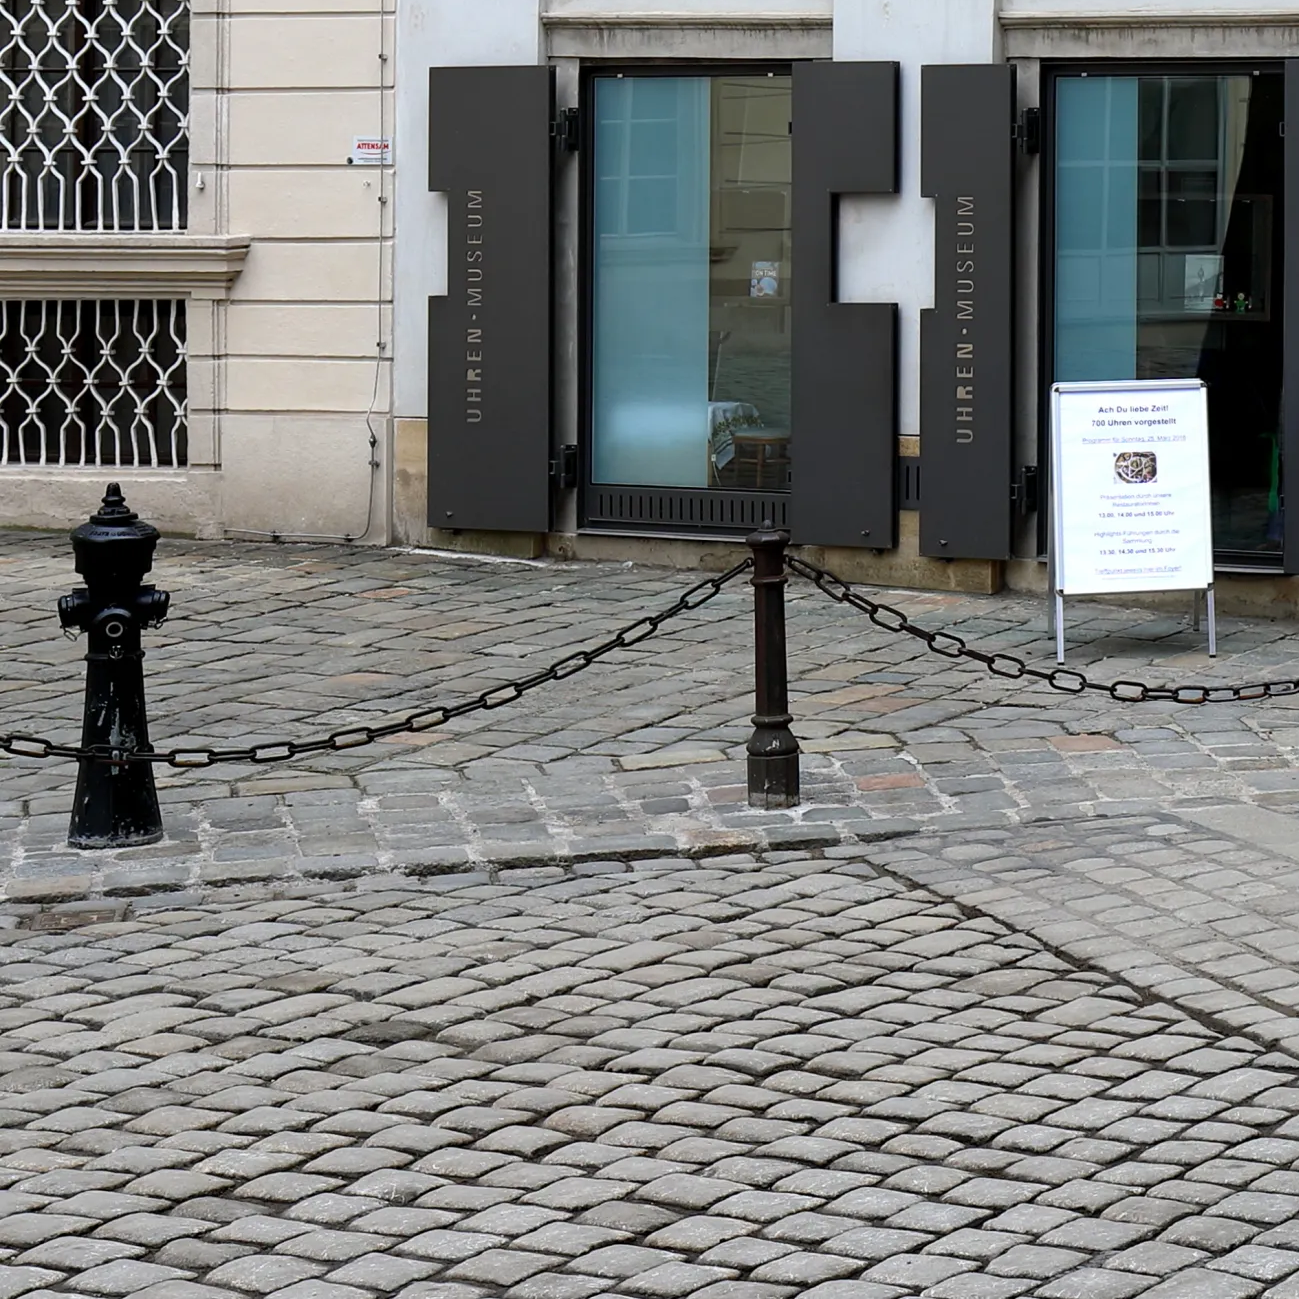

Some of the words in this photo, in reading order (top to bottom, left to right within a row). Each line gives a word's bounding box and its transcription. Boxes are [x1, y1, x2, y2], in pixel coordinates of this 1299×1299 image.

[1098, 406, 1114, 414] Ach
[1130, 405, 1149, 413] liebe
[1108, 419, 1132, 427] Uhren
[1135, 418, 1177, 426] vorgestellt
